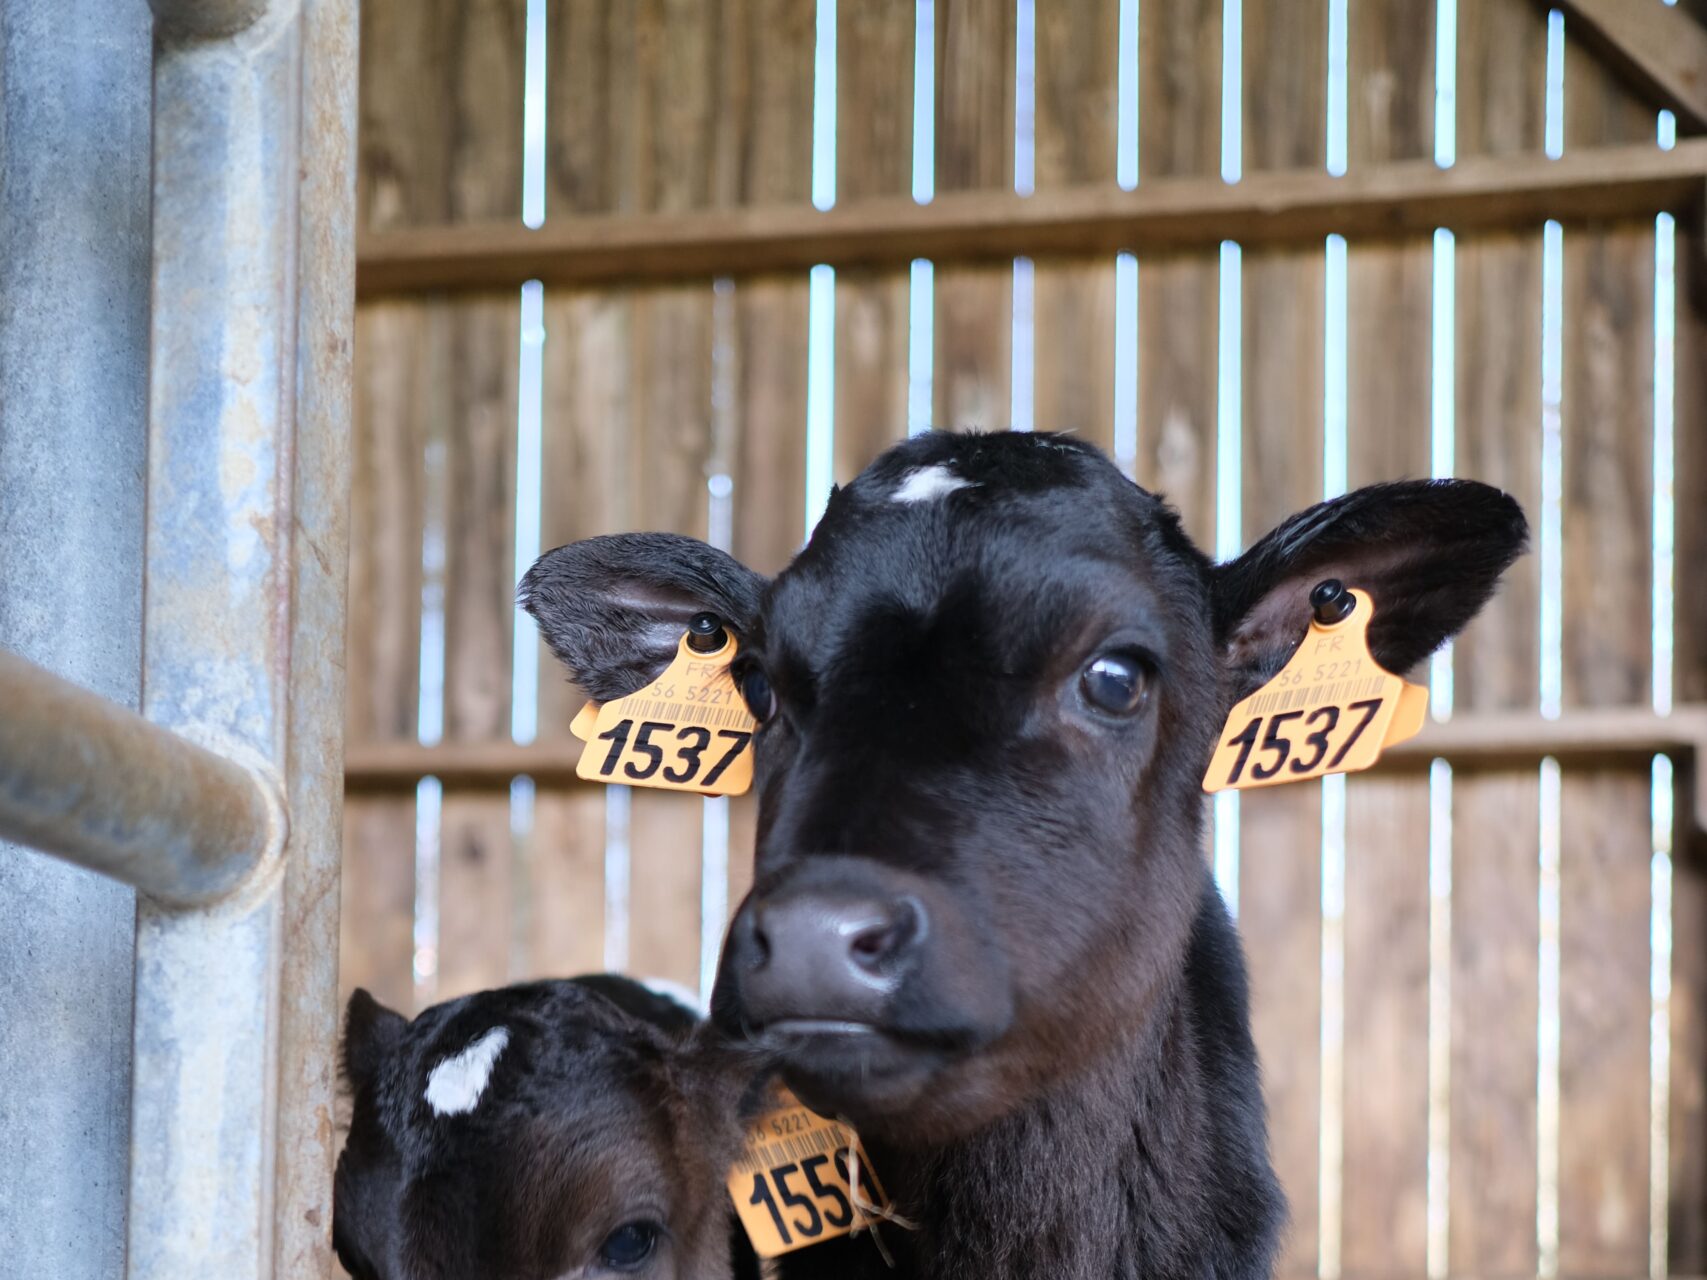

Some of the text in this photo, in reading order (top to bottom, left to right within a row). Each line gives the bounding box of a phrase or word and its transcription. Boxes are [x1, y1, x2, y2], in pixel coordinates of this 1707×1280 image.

[1314, 635, 1345, 655] FR
[685, 661, 714, 678] FR
[1278, 658, 1363, 688] 56 5221
[651, 681, 733, 706] 56 5221
[597, 718, 753, 787] 1537
[1226, 697, 1384, 785] 1537
